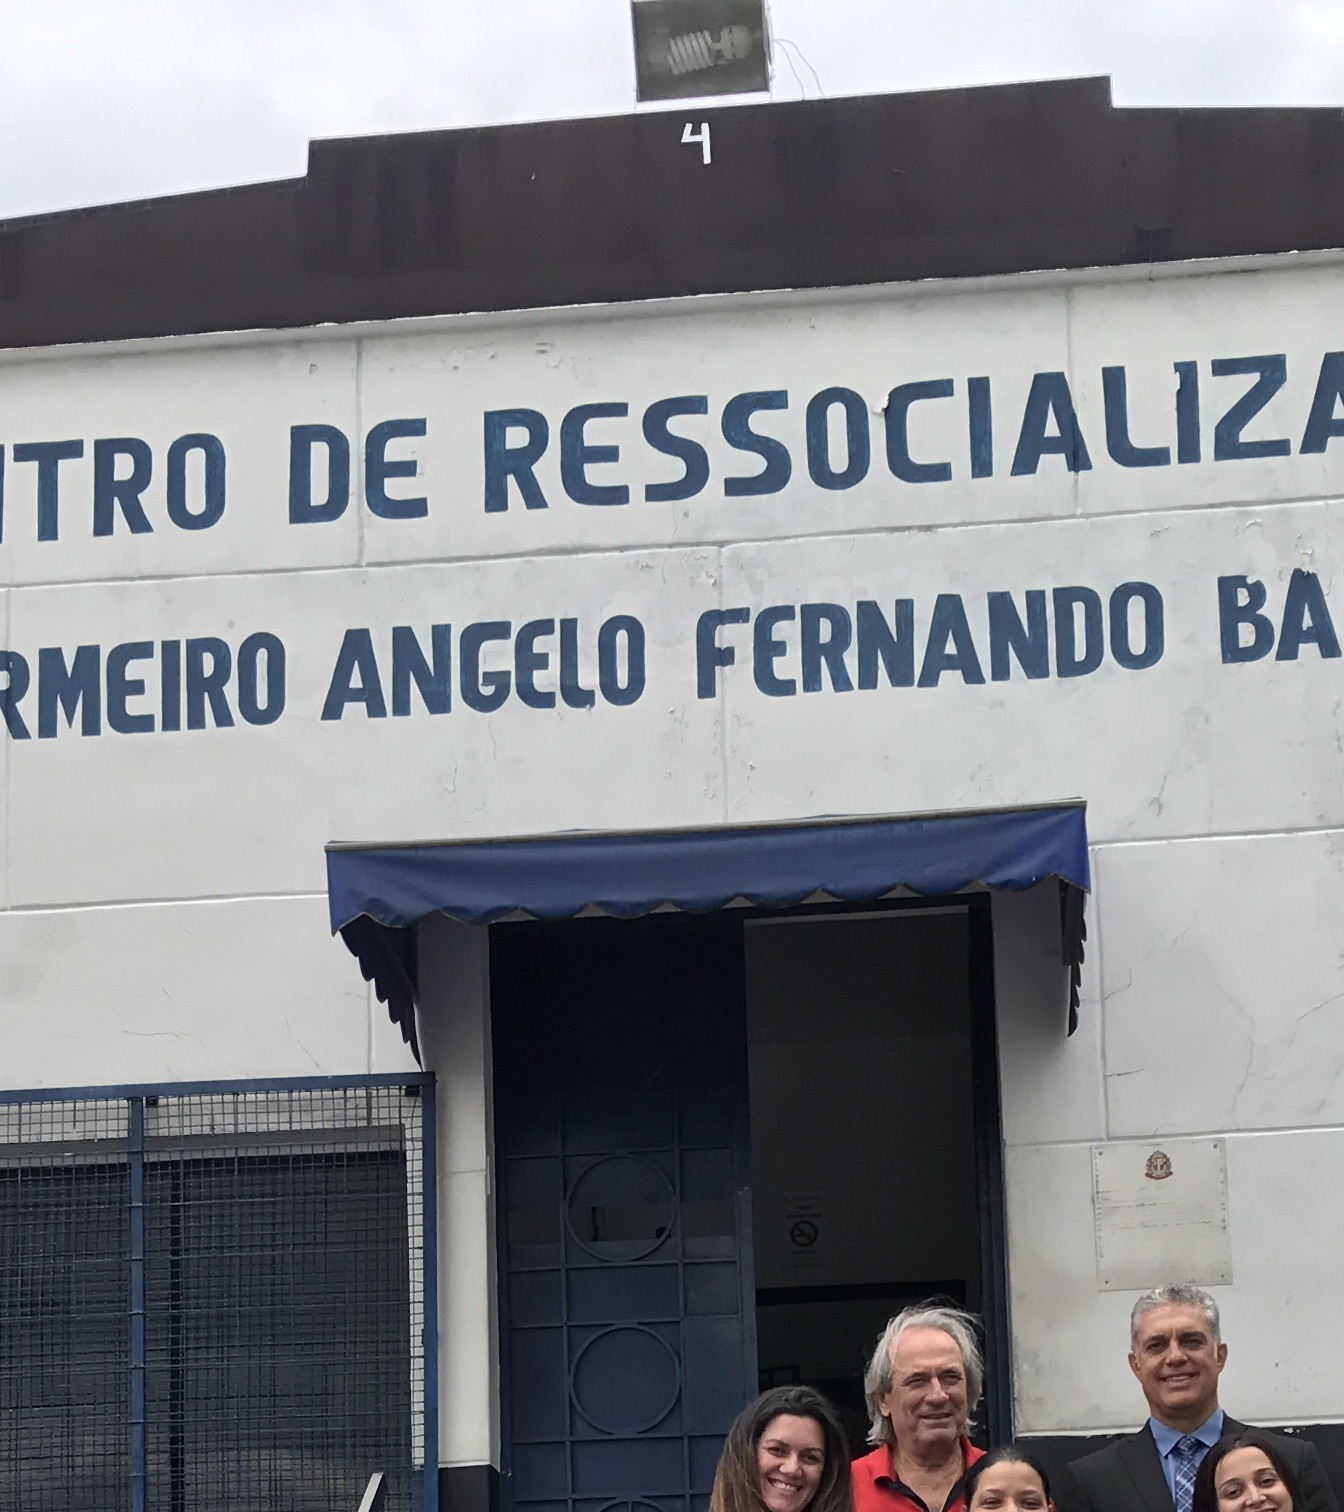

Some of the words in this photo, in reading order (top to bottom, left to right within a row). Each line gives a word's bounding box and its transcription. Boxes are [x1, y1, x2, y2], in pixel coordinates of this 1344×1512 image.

[681, 122, 711, 164] 4
[289, 418, 429, 525] DE
[322, 614, 647, 721] ANGELO
[696, 581, 1166, 700] FERNANDO
